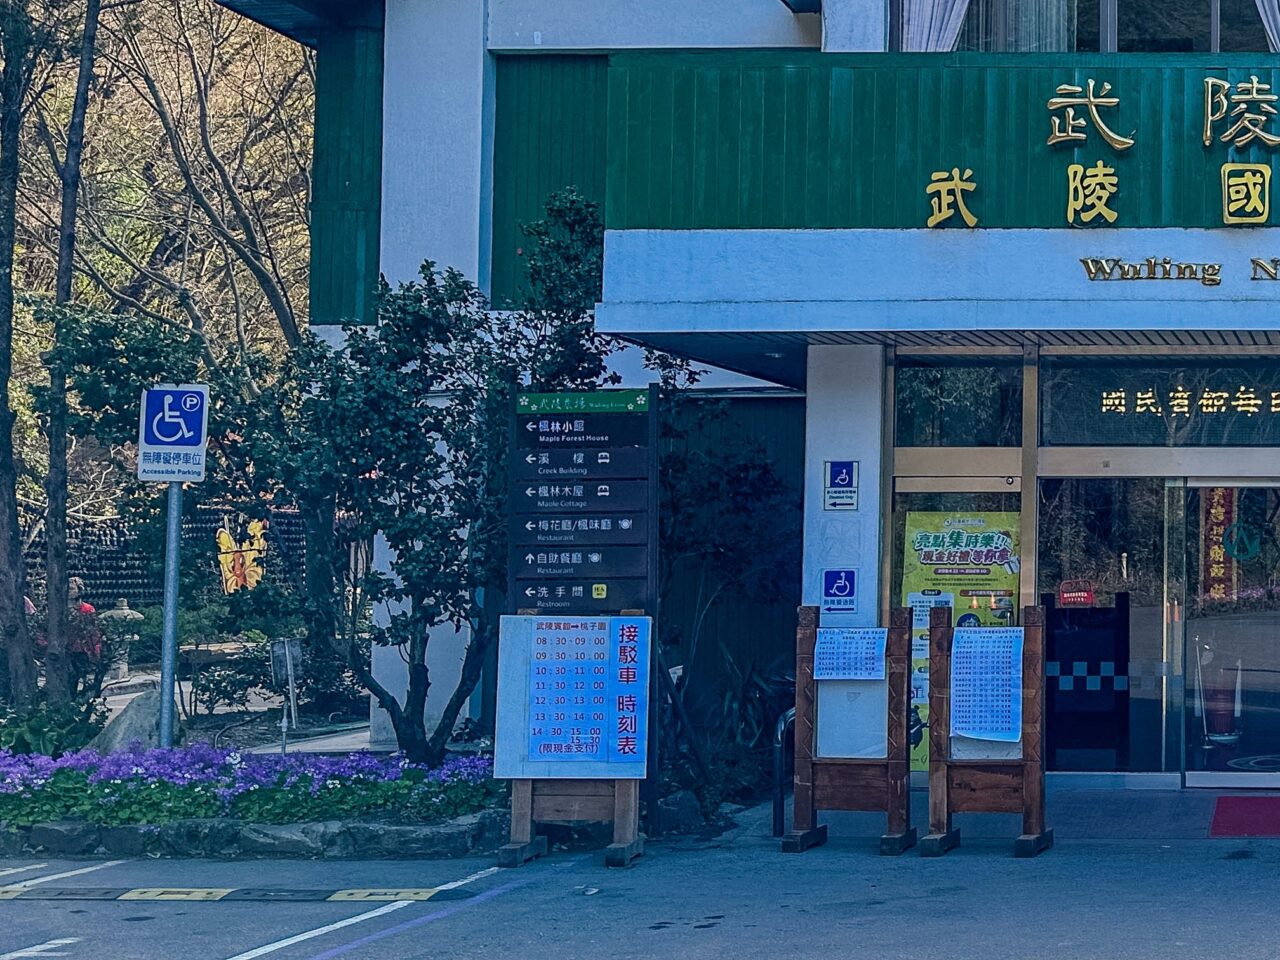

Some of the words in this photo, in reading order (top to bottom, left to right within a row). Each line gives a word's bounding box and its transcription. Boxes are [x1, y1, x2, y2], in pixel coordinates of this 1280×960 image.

[1080, 256, 1222, 286] Wuling
[186, 397, 198, 409] P
[539, 420, 585, 432] 楓林小館
[143, 451, 201, 465] 無障礙停車位
[178, 468, 201, 476] Parking
[559, 467, 587, 475] Building
[538, 485, 584, 497] 楓林木屋
[537, 552, 582, 564] 自助餐廳
[537, 586, 584, 597] 洗手間
[618, 624, 639, 685] 接駁車
[617, 694, 637, 755] 時刻表
